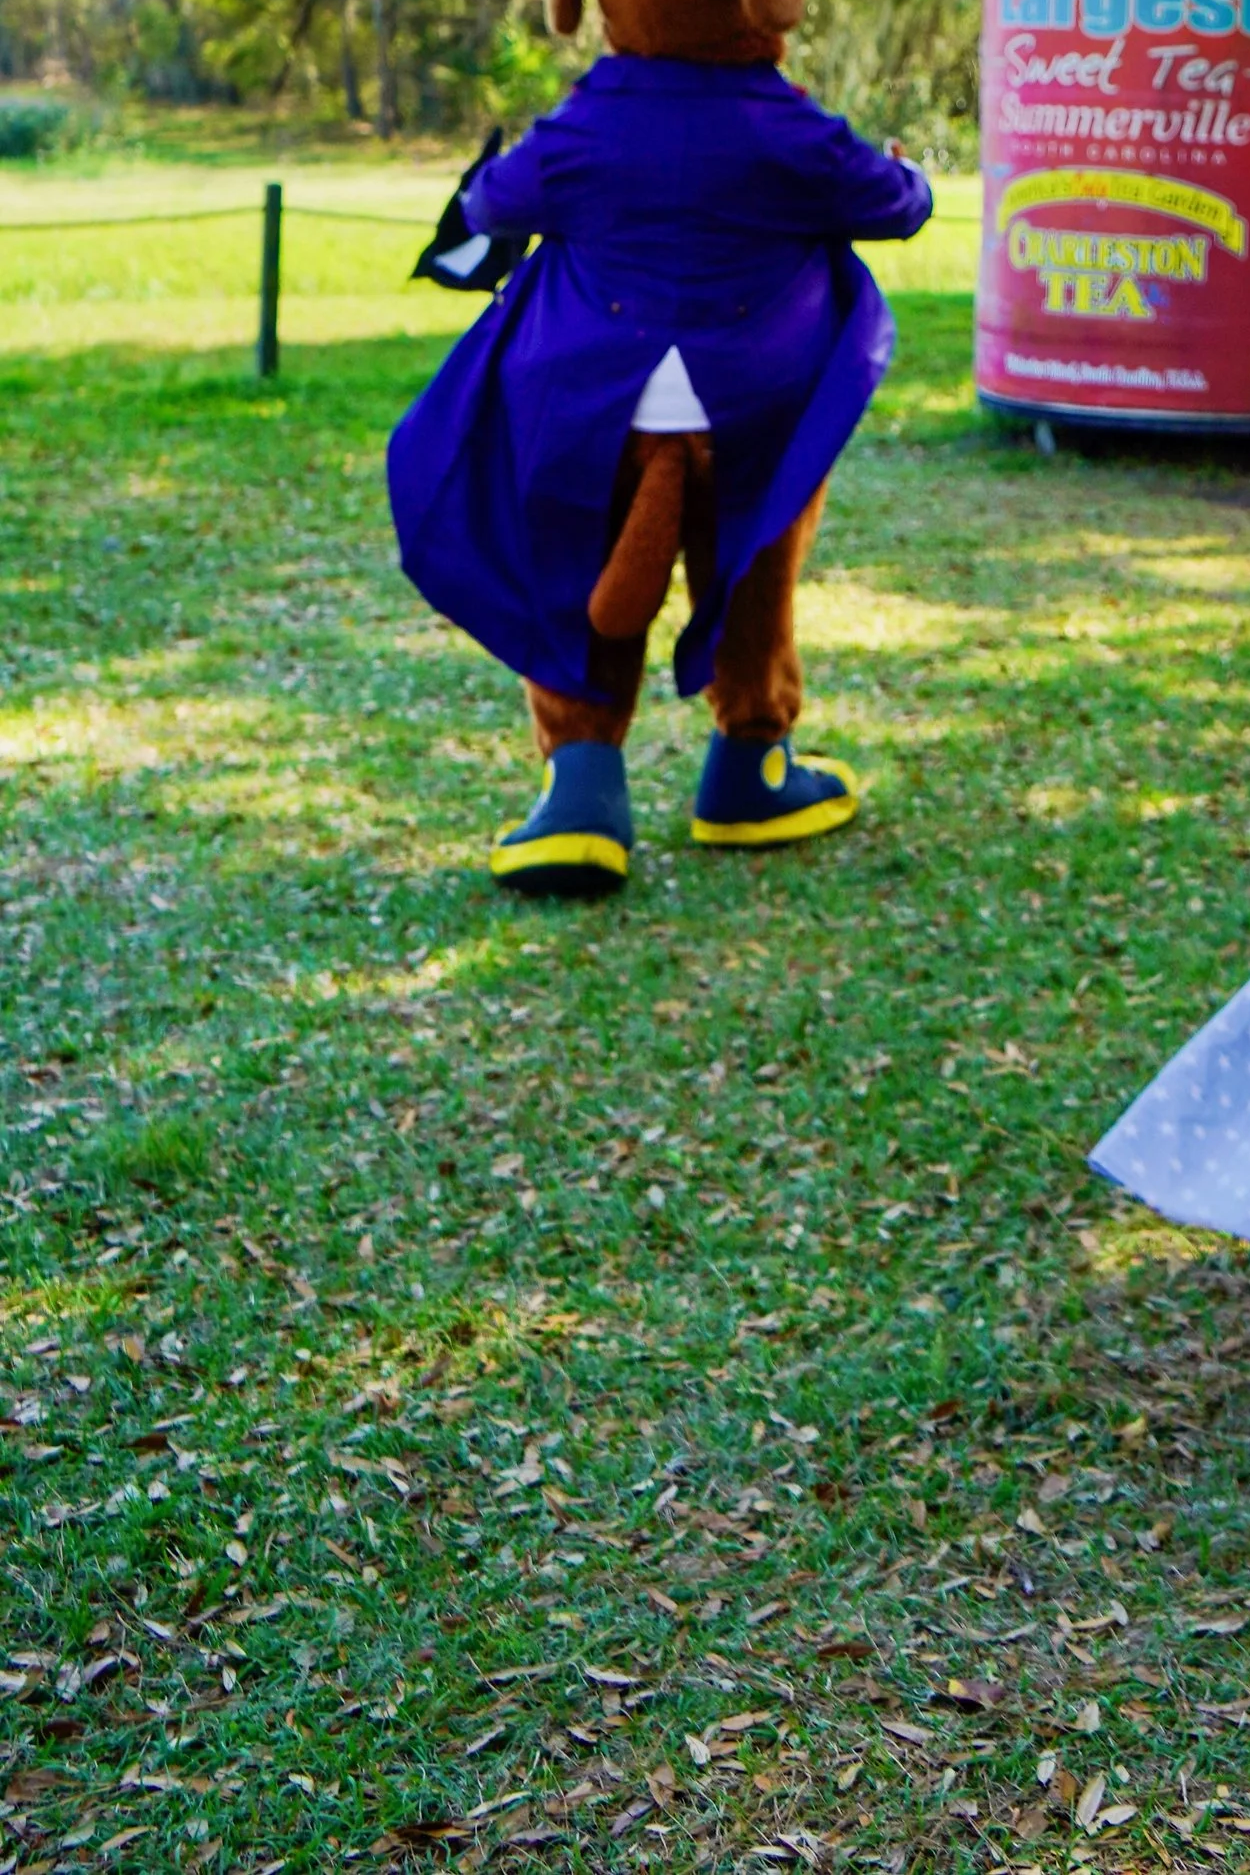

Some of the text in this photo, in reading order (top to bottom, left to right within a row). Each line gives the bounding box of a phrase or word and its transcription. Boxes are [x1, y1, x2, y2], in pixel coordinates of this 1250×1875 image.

[1003, 33, 1124, 95] Sweet
[1008, 220, 1209, 283] CHARLESTON
[1039, 271, 1156, 320] TEA
